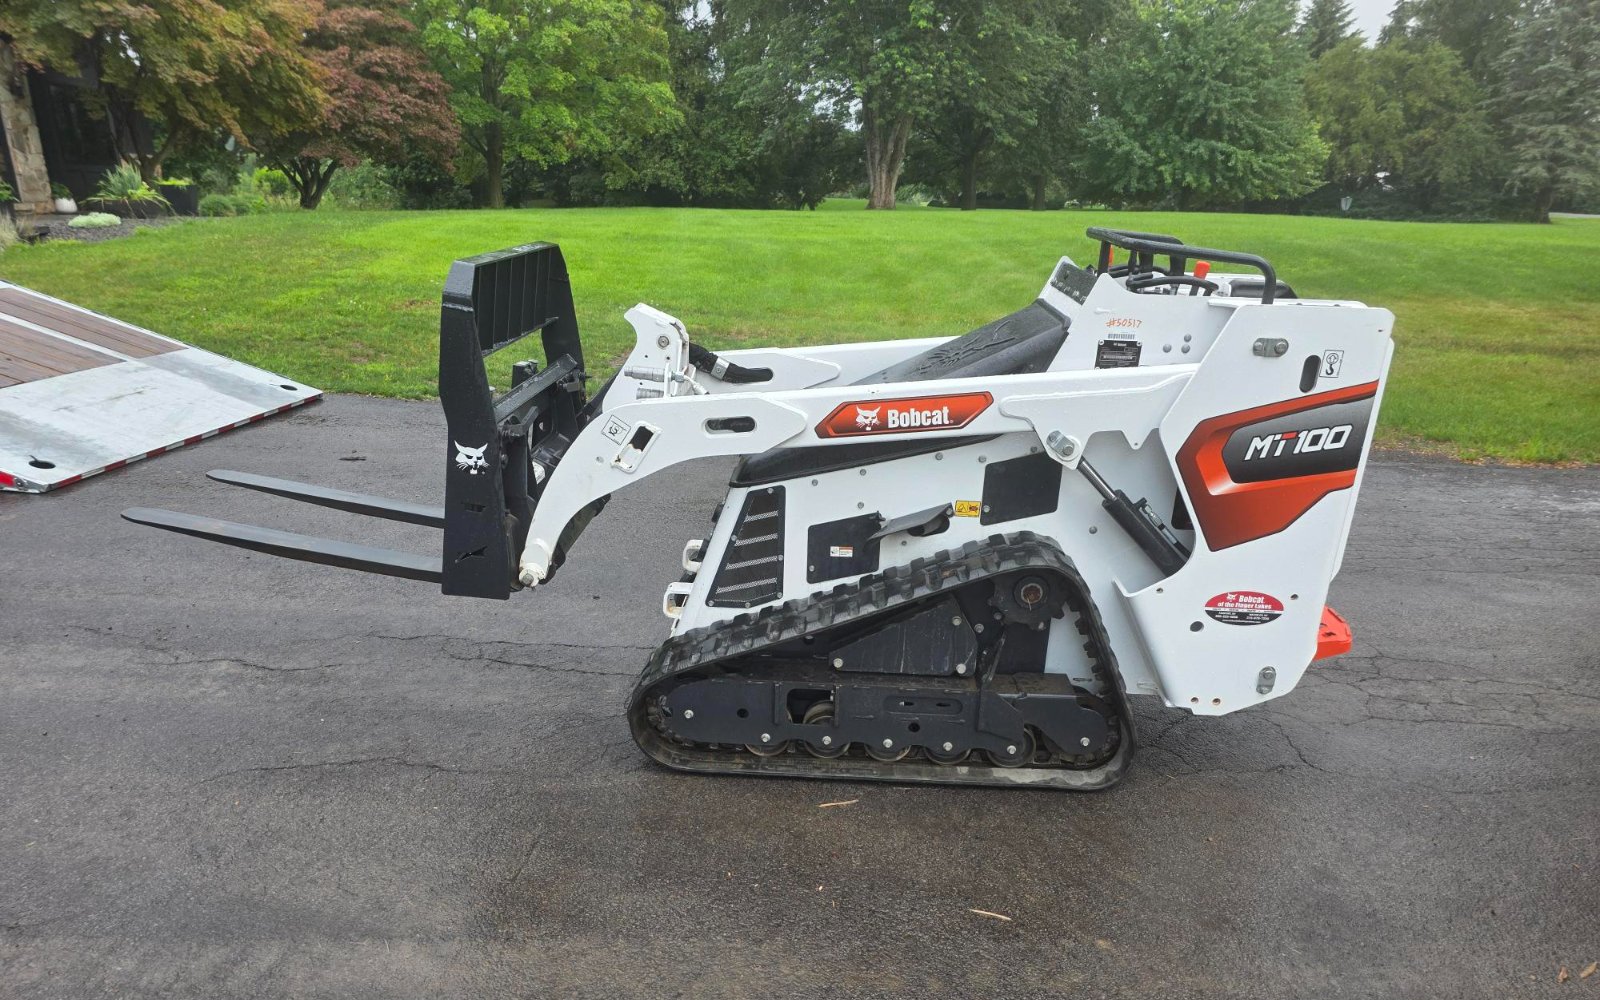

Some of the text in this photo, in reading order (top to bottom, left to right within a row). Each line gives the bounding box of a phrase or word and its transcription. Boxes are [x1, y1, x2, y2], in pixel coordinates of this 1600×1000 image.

[1105, 318, 1142, 328] #50517
[887, 406, 950, 428] Bobcat
[1244, 424, 1353, 461] MT100
[1238, 595, 1265, 604] Bobcat
